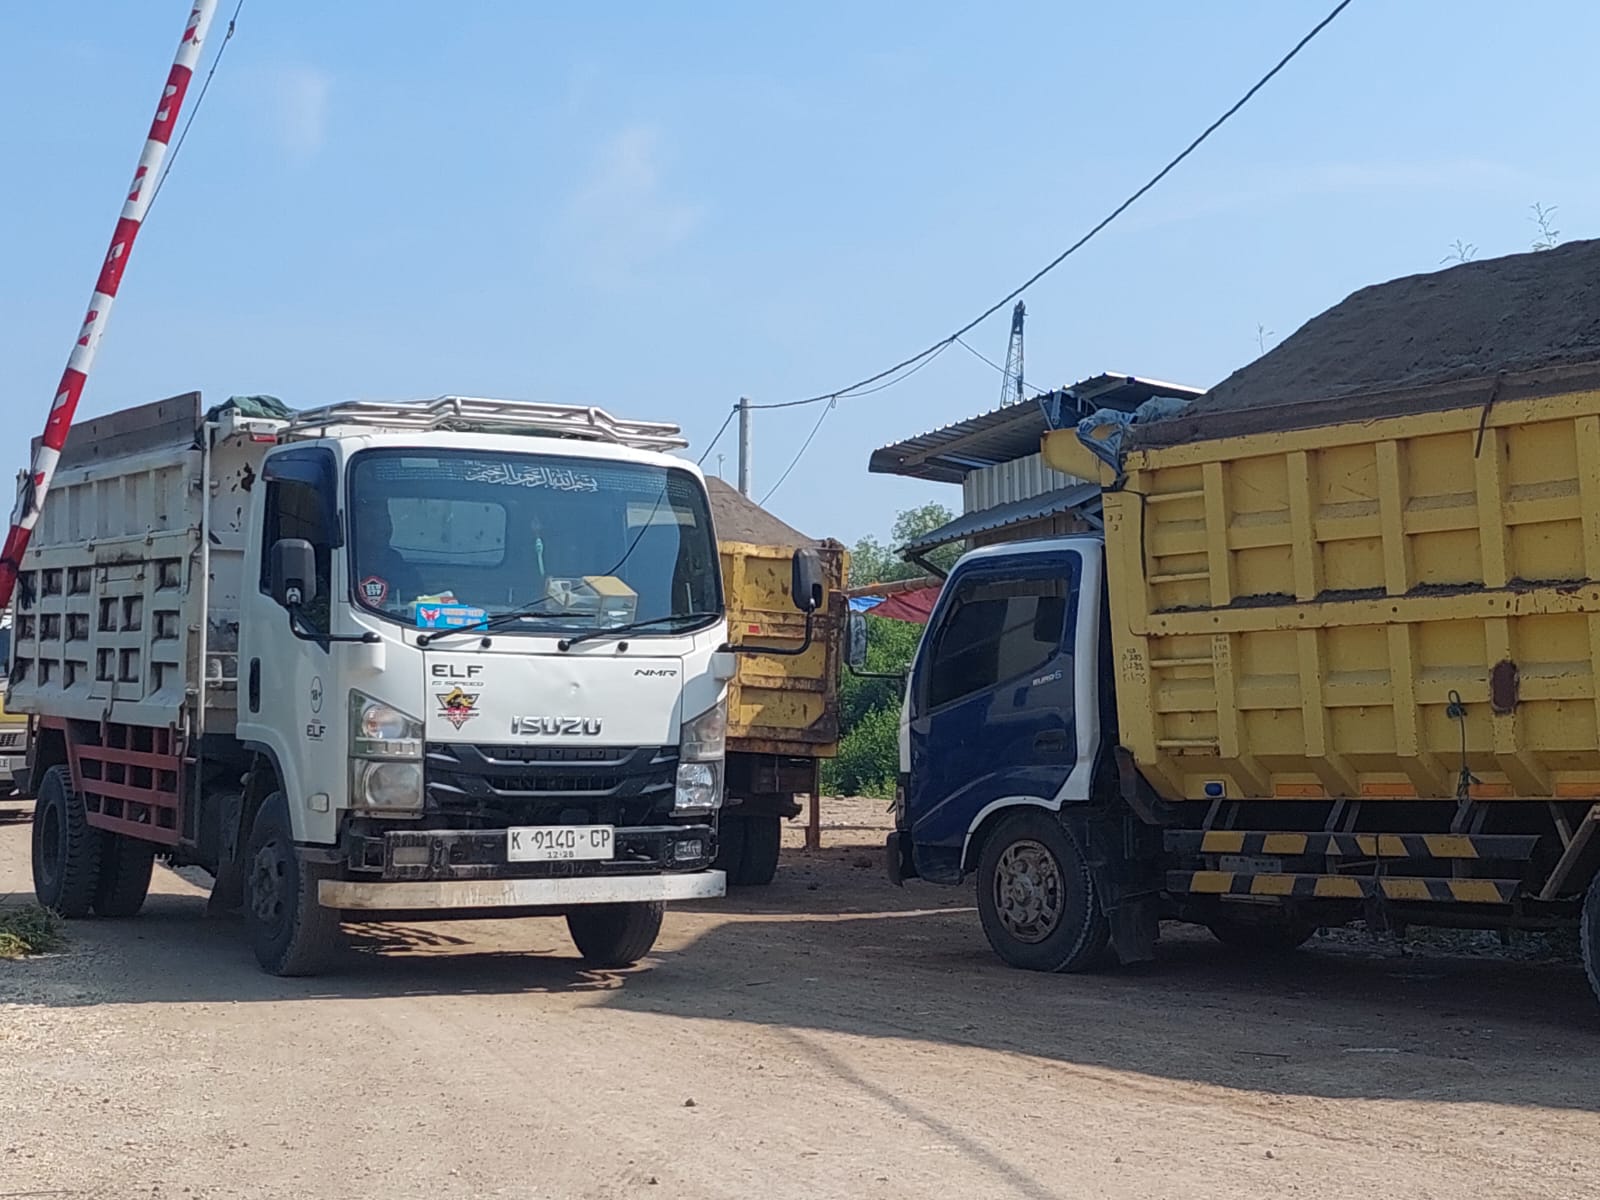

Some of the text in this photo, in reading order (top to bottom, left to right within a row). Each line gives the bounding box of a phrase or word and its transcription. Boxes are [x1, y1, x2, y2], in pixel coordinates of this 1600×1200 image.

[432, 664, 483, 678] ELF
[634, 669, 677, 677] NMR
[306, 724, 326, 737] ELF
[511, 715, 603, 736] ISUZU
[511, 829, 610, 850] K 9140 CP
